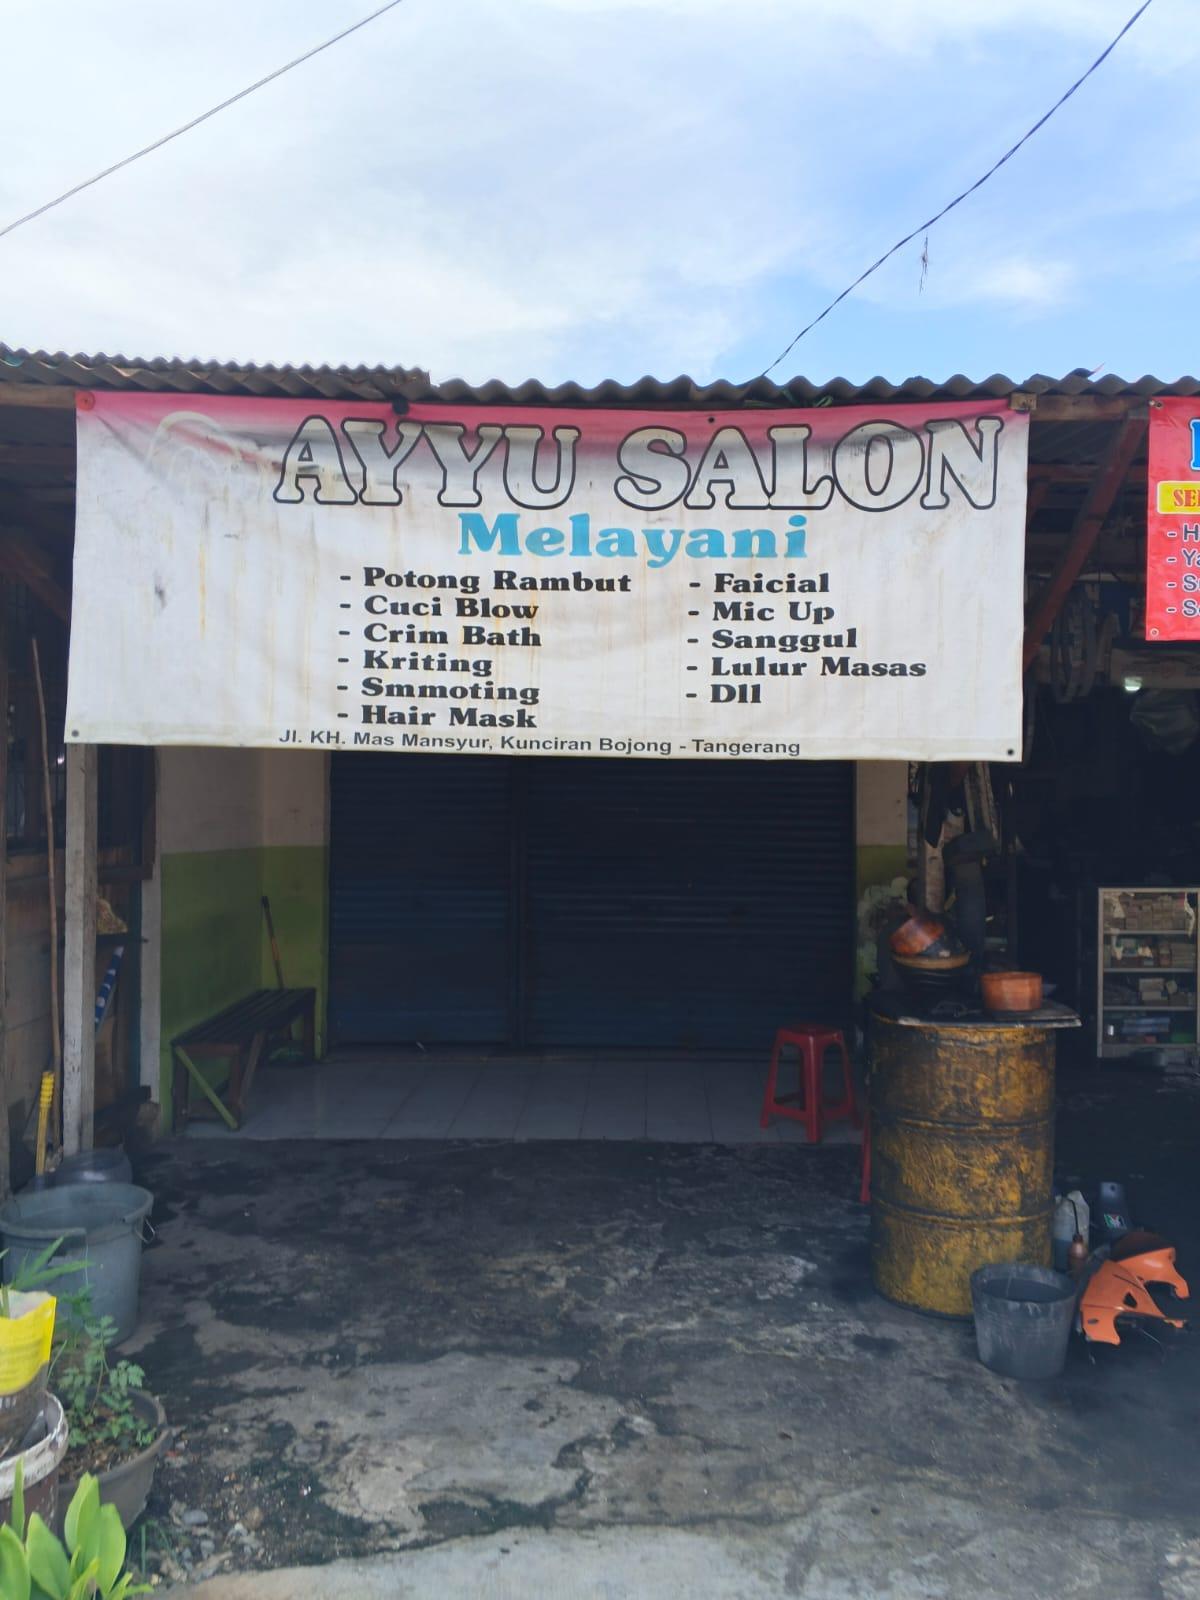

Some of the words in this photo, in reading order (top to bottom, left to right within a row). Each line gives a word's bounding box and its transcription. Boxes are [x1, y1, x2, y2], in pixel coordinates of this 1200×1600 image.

[273, 415, 581, 510] AYYU
[614, 416, 1004, 512] SALON
[459, 512, 808, 568] Melayani
[364, 567, 479, 594] Potong
[494, 571, 632, 592] Rambut
[714, 573, 829, 593] Faicial
[365, 595, 441, 617] Cuci
[456, 598, 539, 619] Blow
[713, 601, 775, 622] Mic
[789, 602, 835, 625] Up
[364, 623, 448, 645] Crim
[463, 626, 542, 647] Bath
[712, 627, 857, 652] Sanggul
[364, 650, 493, 677] Kriting
[712, 657, 808, 676] Lulur
[821, 657, 927, 677] Masas
[362, 676, 540, 706] Smmoting
[711, 684, 761, 704] Dll
[362, 705, 436, 726] Hair
[450, 708, 537, 729] Mask
[310, 731, 346, 745] KH.
[354, 732, 395, 746] Mas
[402, 734, 493, 751] Mansyur,
[501, 736, 592, 751] Kunciran
[600, 738, 672, 756] Bojong
[691, 739, 800, 757] Tangerang
